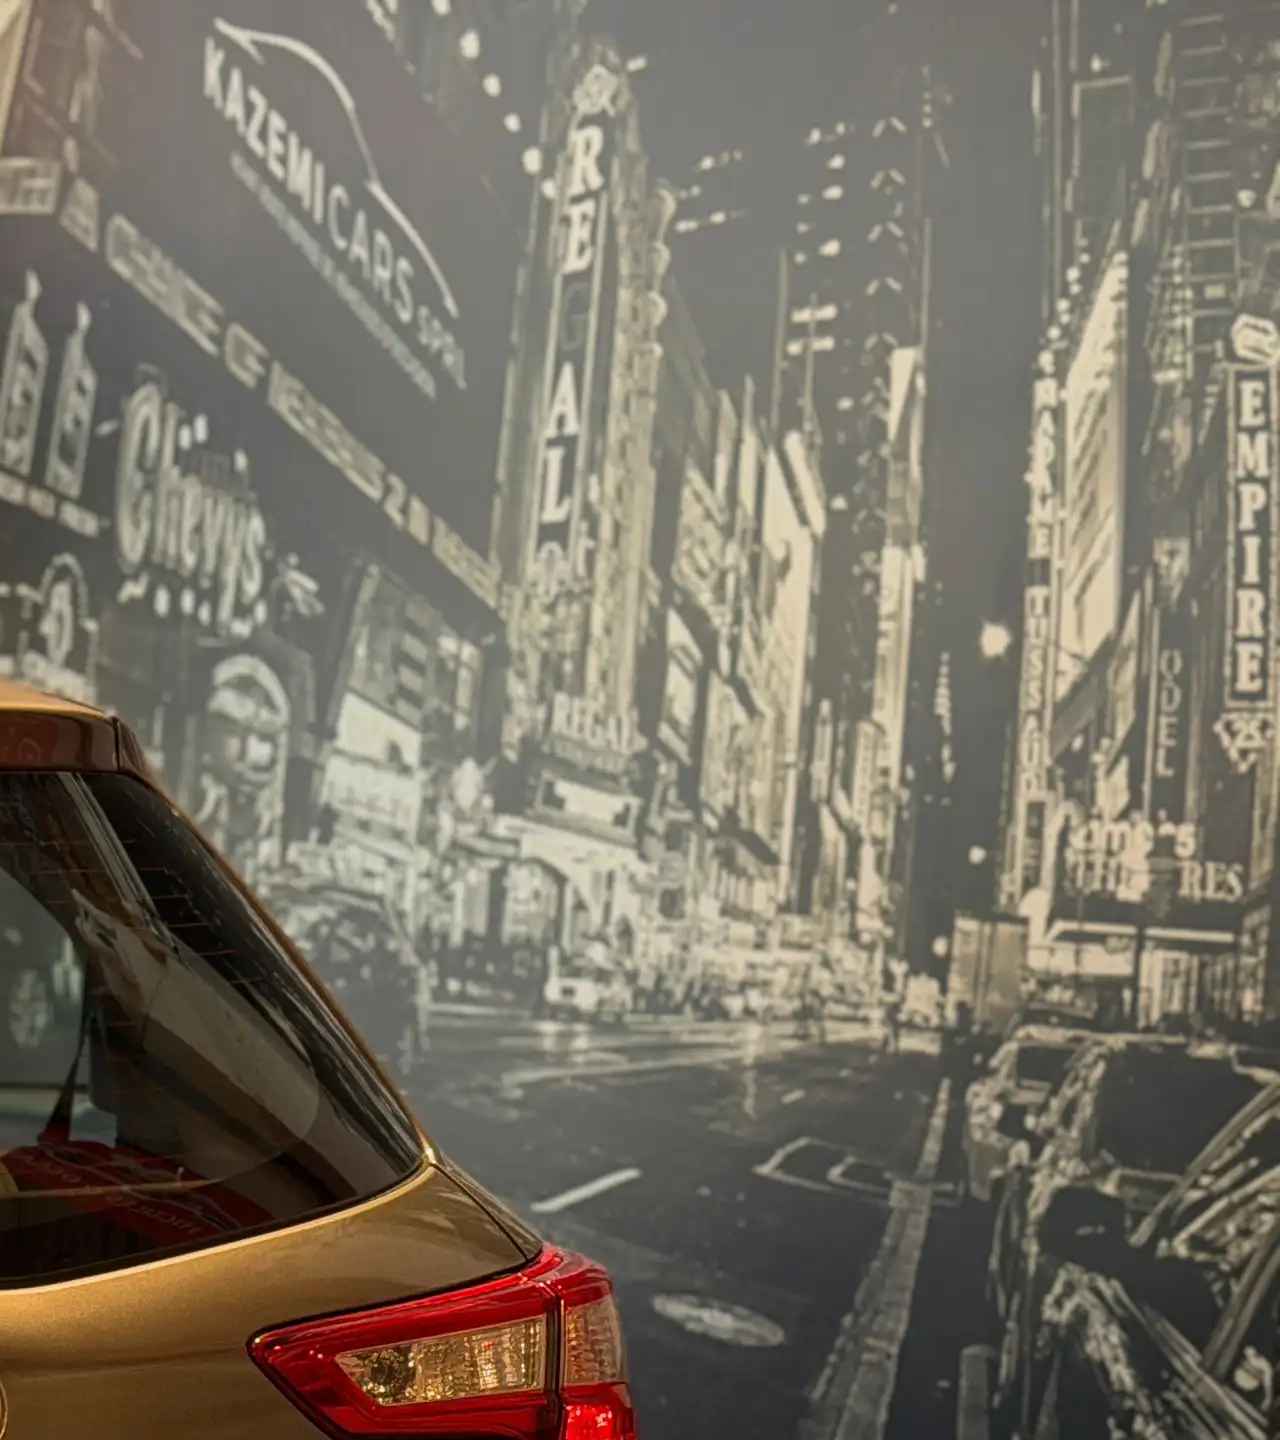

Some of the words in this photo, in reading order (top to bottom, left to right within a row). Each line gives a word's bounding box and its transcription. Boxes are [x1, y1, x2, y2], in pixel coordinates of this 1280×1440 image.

[203, 36, 325, 225] KAZEMI
[328, 183, 415, 324] CARS
[118, 382, 266, 630] Chevys
[1235, 380, 1270, 694] EMPIRE
